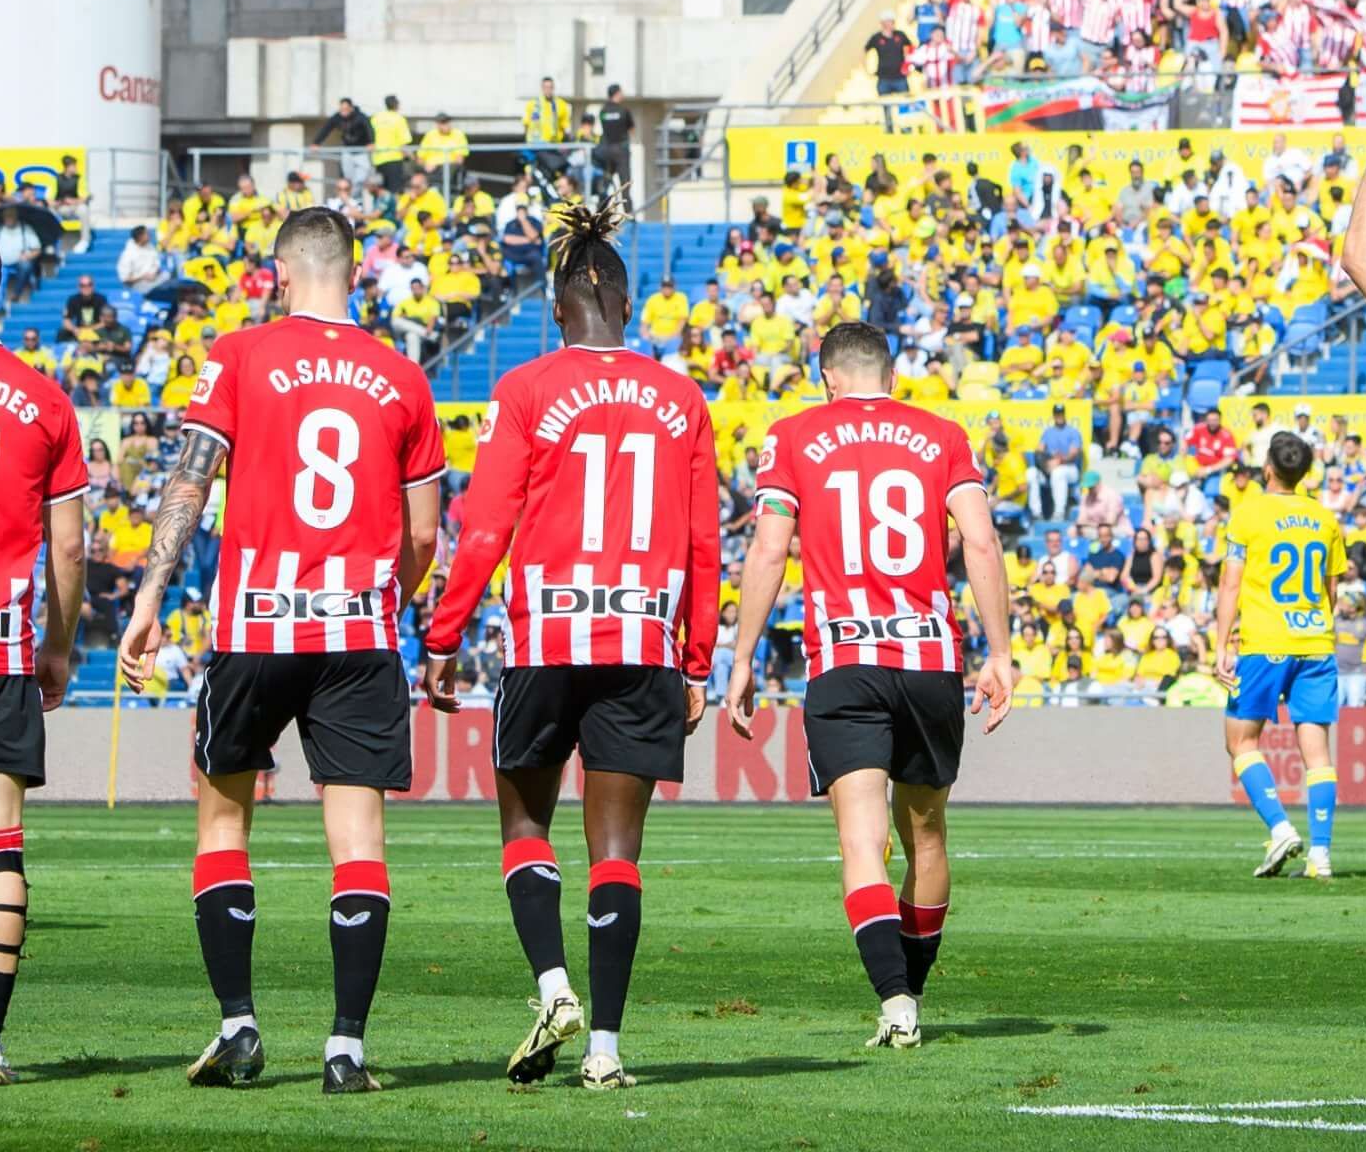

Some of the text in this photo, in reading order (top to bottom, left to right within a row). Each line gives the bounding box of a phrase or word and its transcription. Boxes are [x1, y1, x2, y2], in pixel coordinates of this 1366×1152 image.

[268, 357, 401, 408] O.SANCET
[535, 378, 690, 444] WILLIAMS JR
[292, 407, 361, 530] 8
[802, 421, 942, 465] DE MARCOS
[570, 432, 656, 553] 11
[824, 468, 926, 577] 18
[1275, 515, 1321, 531] KIRIAN
[1269, 540, 1328, 604] 20
[243, 589, 374, 620] DIGI
[540, 586, 669, 619] DIGI
[827, 614, 942, 645] DIGI
